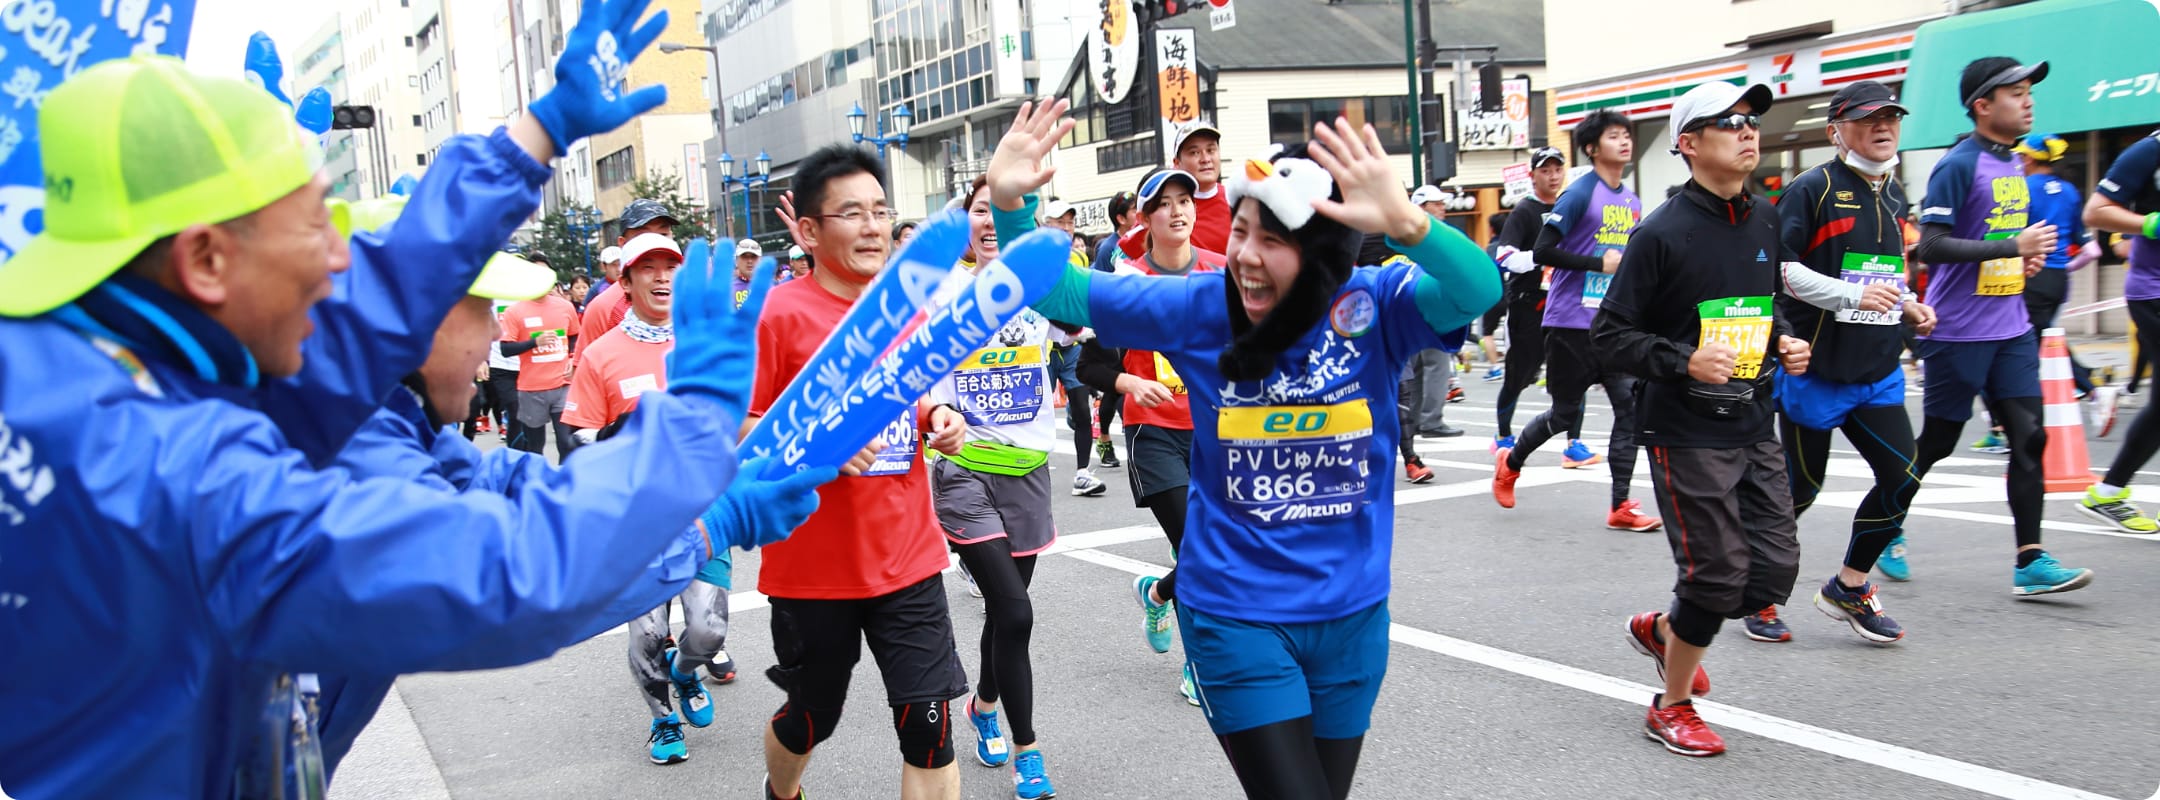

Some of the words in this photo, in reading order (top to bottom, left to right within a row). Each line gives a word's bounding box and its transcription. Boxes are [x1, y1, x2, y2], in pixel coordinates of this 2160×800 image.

[1163, 33, 1194, 132] 海鮮・地
[1463, 123, 1512, 146] 地どり
[1862, 261, 1896, 271] mineo
[1725, 306, 1762, 317] mineo
[883, 320, 986, 404] NPO法人
[979, 349, 1017, 365] eo
[956, 371, 1032, 393] 百合&菊丸ママ
[1322, 381, 1361, 404] VOLUNTEER
[959, 395, 971, 411] K
[975, 391, 1013, 410] 868
[1263, 411, 1328, 433] eo
[1226, 475, 1245, 500] K
[1252, 472, 1316, 501] 866
